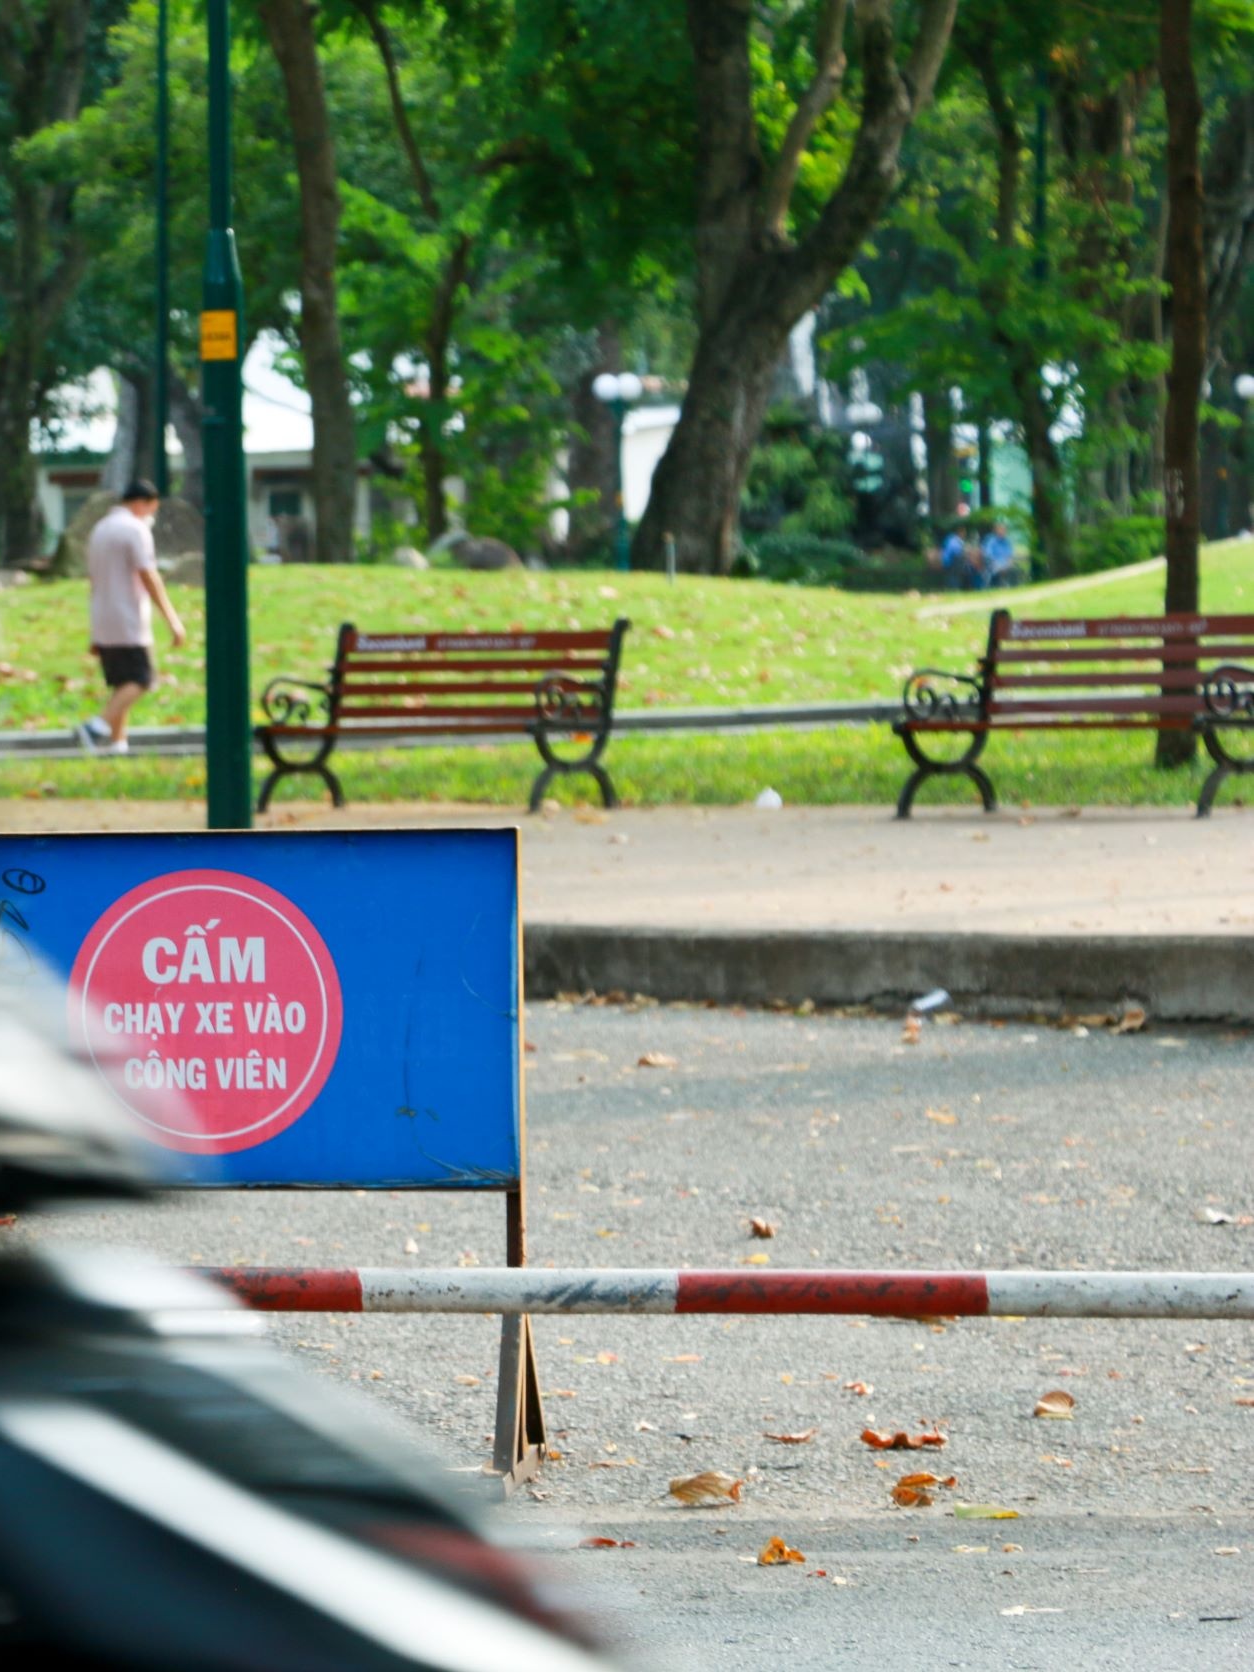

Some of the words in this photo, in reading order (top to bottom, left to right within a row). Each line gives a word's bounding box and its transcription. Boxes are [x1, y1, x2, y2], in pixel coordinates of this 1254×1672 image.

[142, 918, 266, 984] CẤM
[104, 1002, 185, 1041] CHẠY
[195, 1002, 234, 1034] XE
[243, 993, 306, 1034] VÀO
[124, 1049, 206, 1090] CÔNG
[215, 1049, 287, 1090] VIÊN
